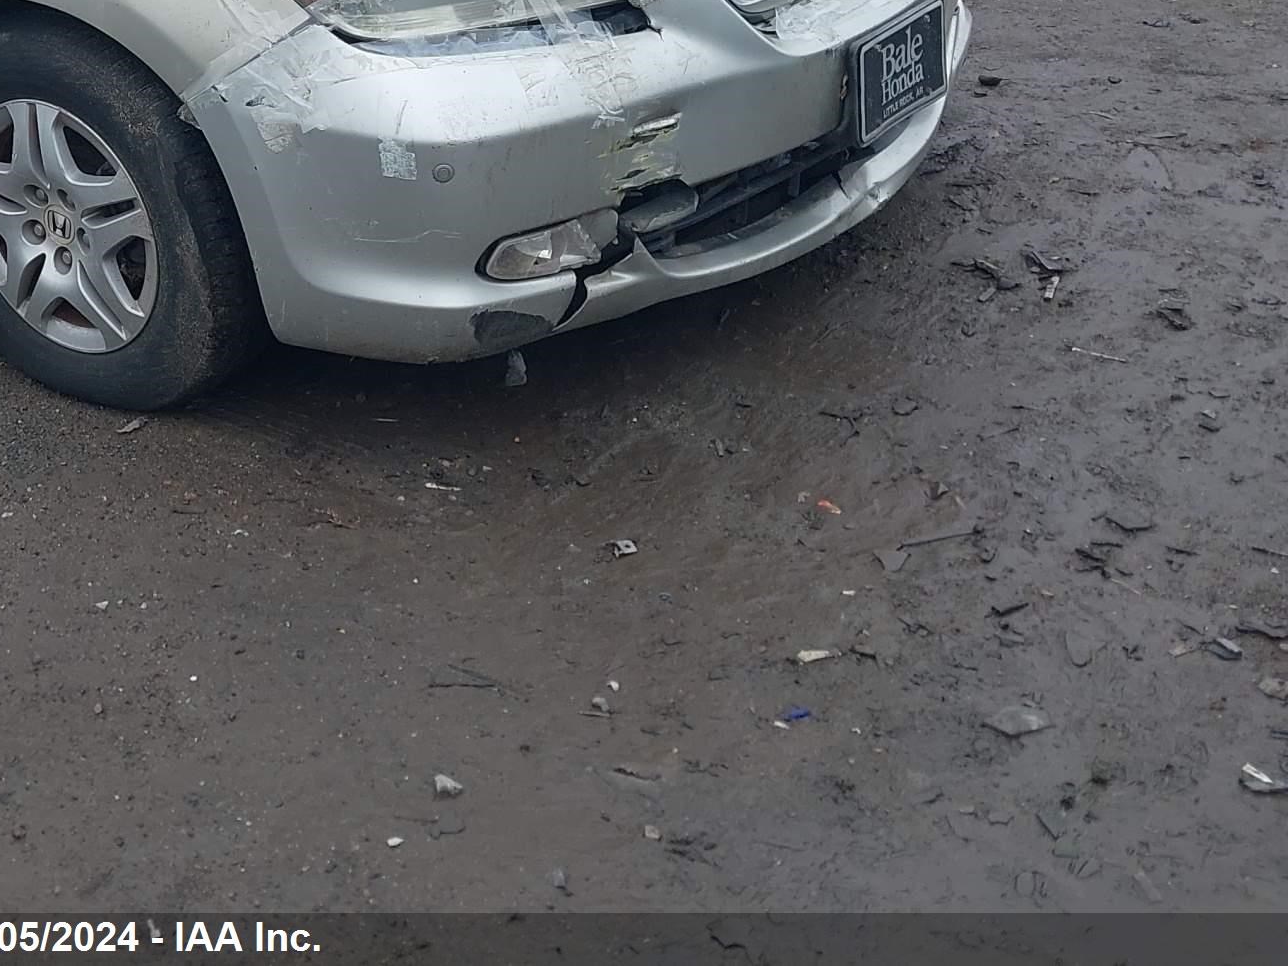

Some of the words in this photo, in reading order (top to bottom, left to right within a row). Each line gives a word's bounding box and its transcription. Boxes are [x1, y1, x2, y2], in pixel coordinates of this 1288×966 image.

[881, 25, 923, 82] Bale
[881, 61, 924, 106] Honda
[883, 101, 899, 119] LITTLE
[915, 85, 924, 99] AR
